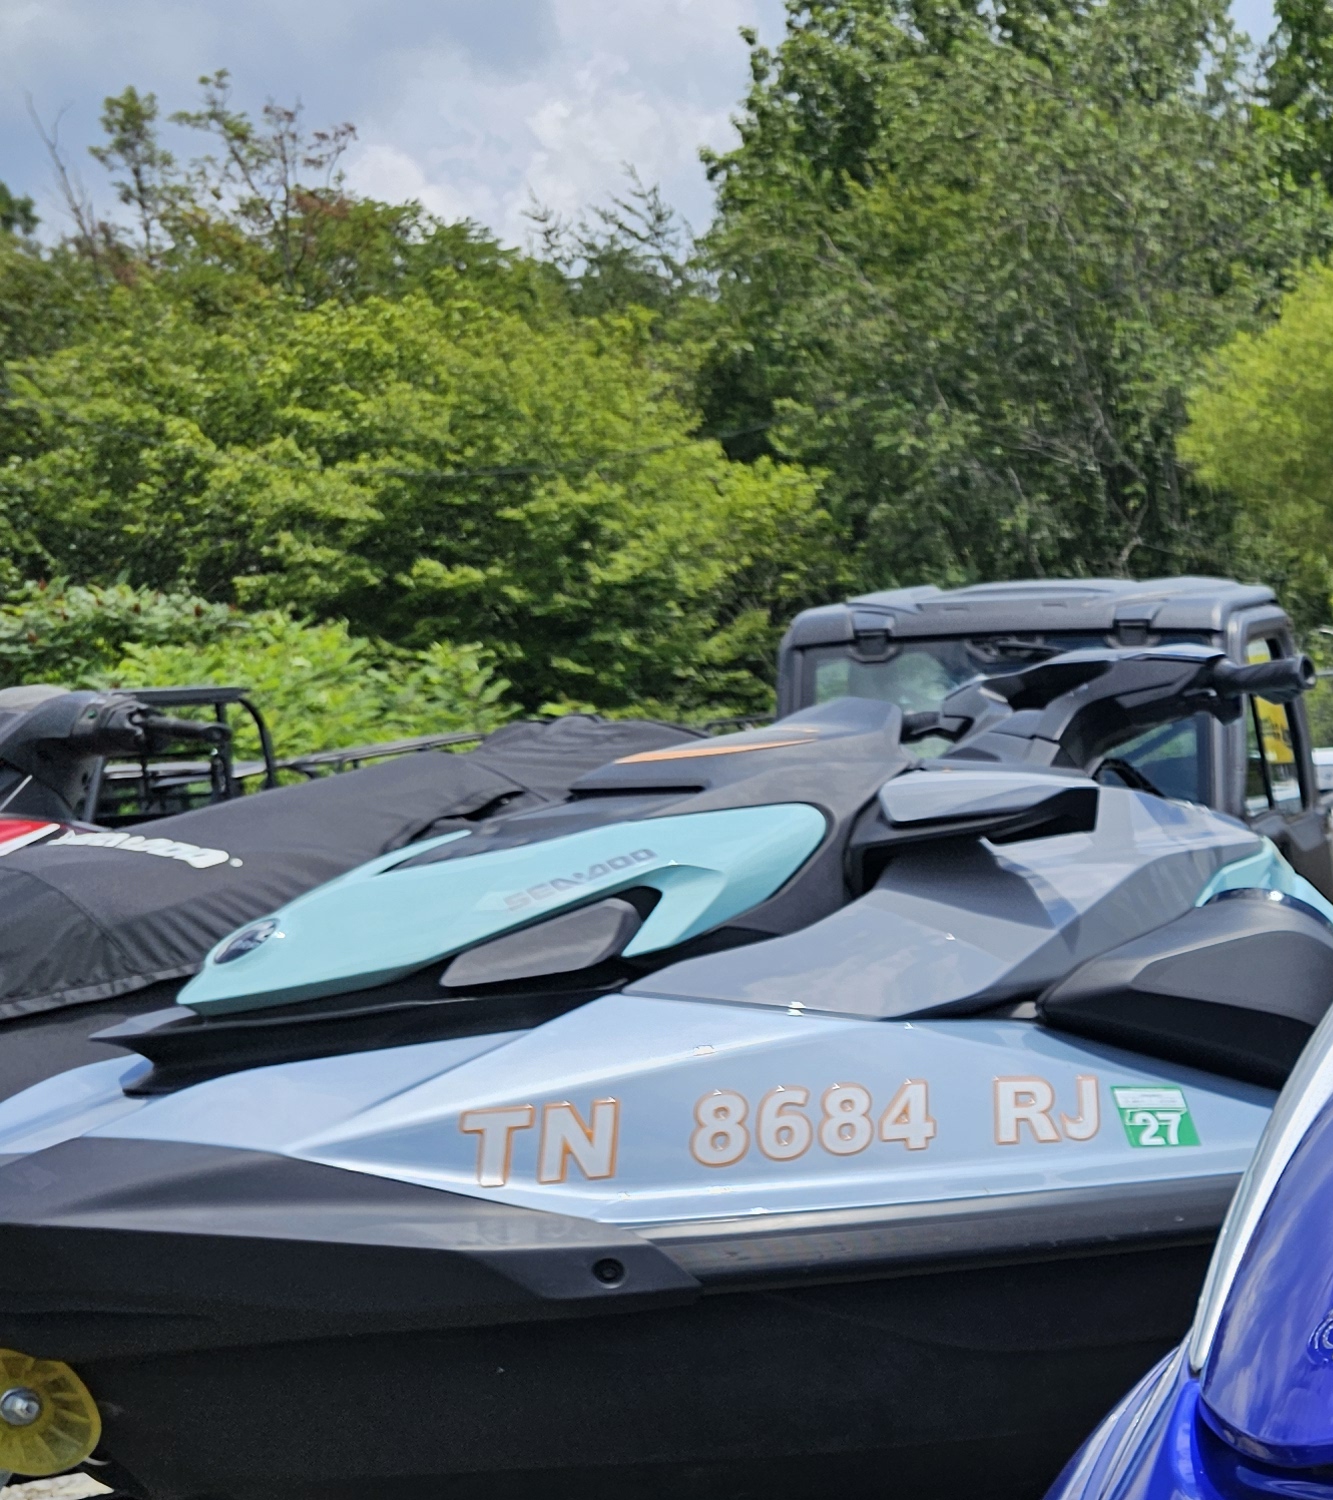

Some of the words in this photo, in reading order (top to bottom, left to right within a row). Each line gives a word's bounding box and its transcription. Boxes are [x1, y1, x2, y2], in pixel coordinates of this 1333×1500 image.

[460, 1096, 620, 1187] TN
[690, 1078, 937, 1168] 8684
[992, 1075, 1101, 1145] RJ
[1133, 1110, 1182, 1146] 27
